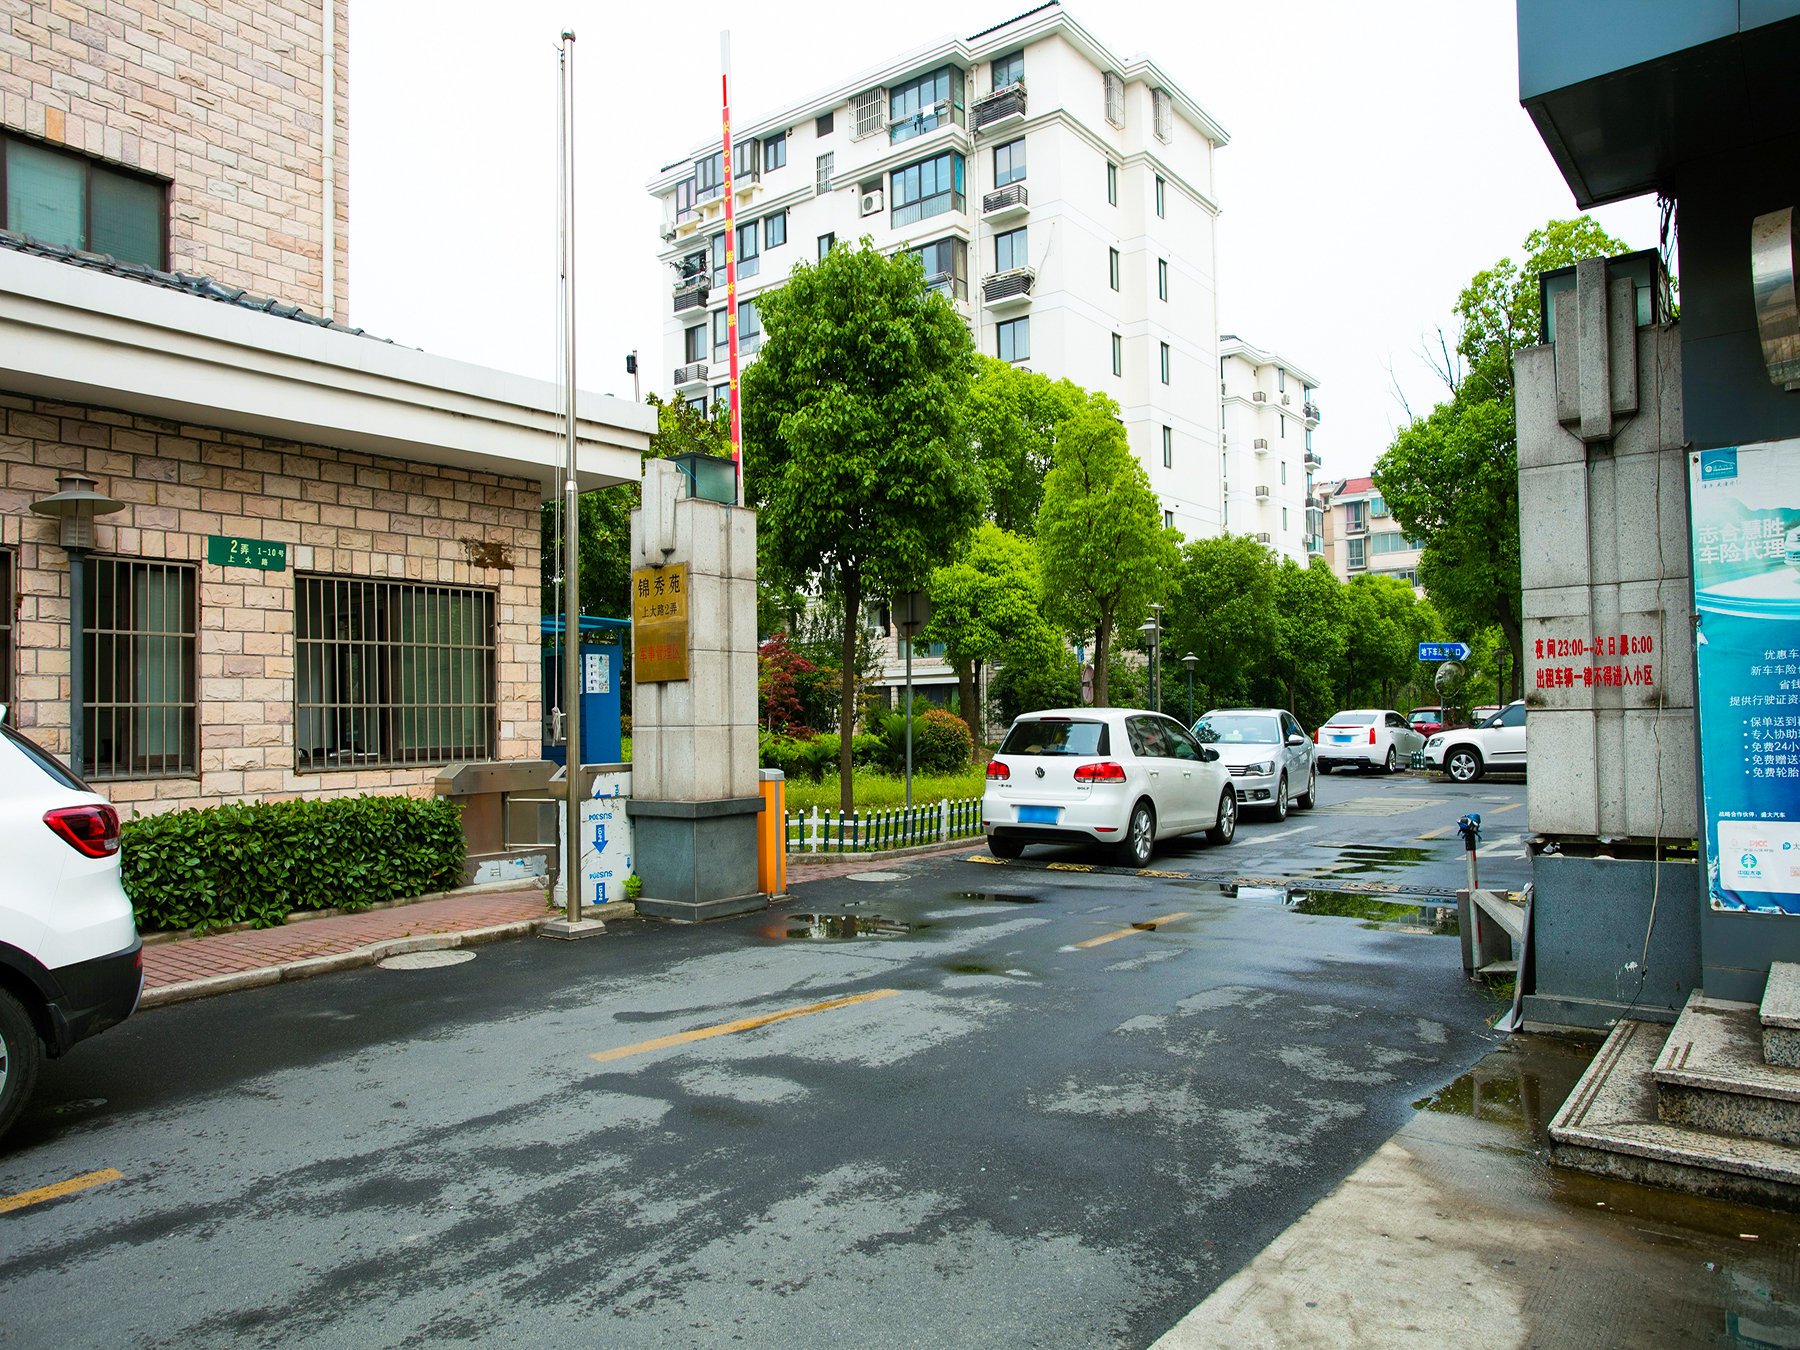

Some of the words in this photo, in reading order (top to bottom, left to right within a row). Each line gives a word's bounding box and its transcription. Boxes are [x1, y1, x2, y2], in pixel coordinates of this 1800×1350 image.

[1698, 517, 1785, 544] 志合慧胜
[230, 539, 250, 555] 2弄
[257, 547, 284, 557] 1-10号
[1698, 537, 1786, 564] 车险代理
[227, 555, 268, 566] 上大路
[637, 573, 681, 598] 锦秀苑
[641, 602, 677, 618] 上大路2弄
[639, 643, 681, 662] 军事管理区
[1421, 647, 1461, 657] 地下车出口
[1764, 649, 1800, 660] 优惠车
[1536, 664, 1654, 688] 出租车辆一律不得进入小区
[1750, 664, 1800, 676] 新车车险
[1729, 694, 1800, 707] 提供行驶证资
[1750, 716, 1800, 727] 保单送到
[1751, 728, 1800, 740] 专人协助
[1751, 741, 1800, 752] 免费24小
[1752, 754, 1800, 765] 免费赠送
[1753, 767, 1800, 778] 免费轮胎
[588, 812, 613, 821] SUS304
[589, 870, 613, 880] SUS304
